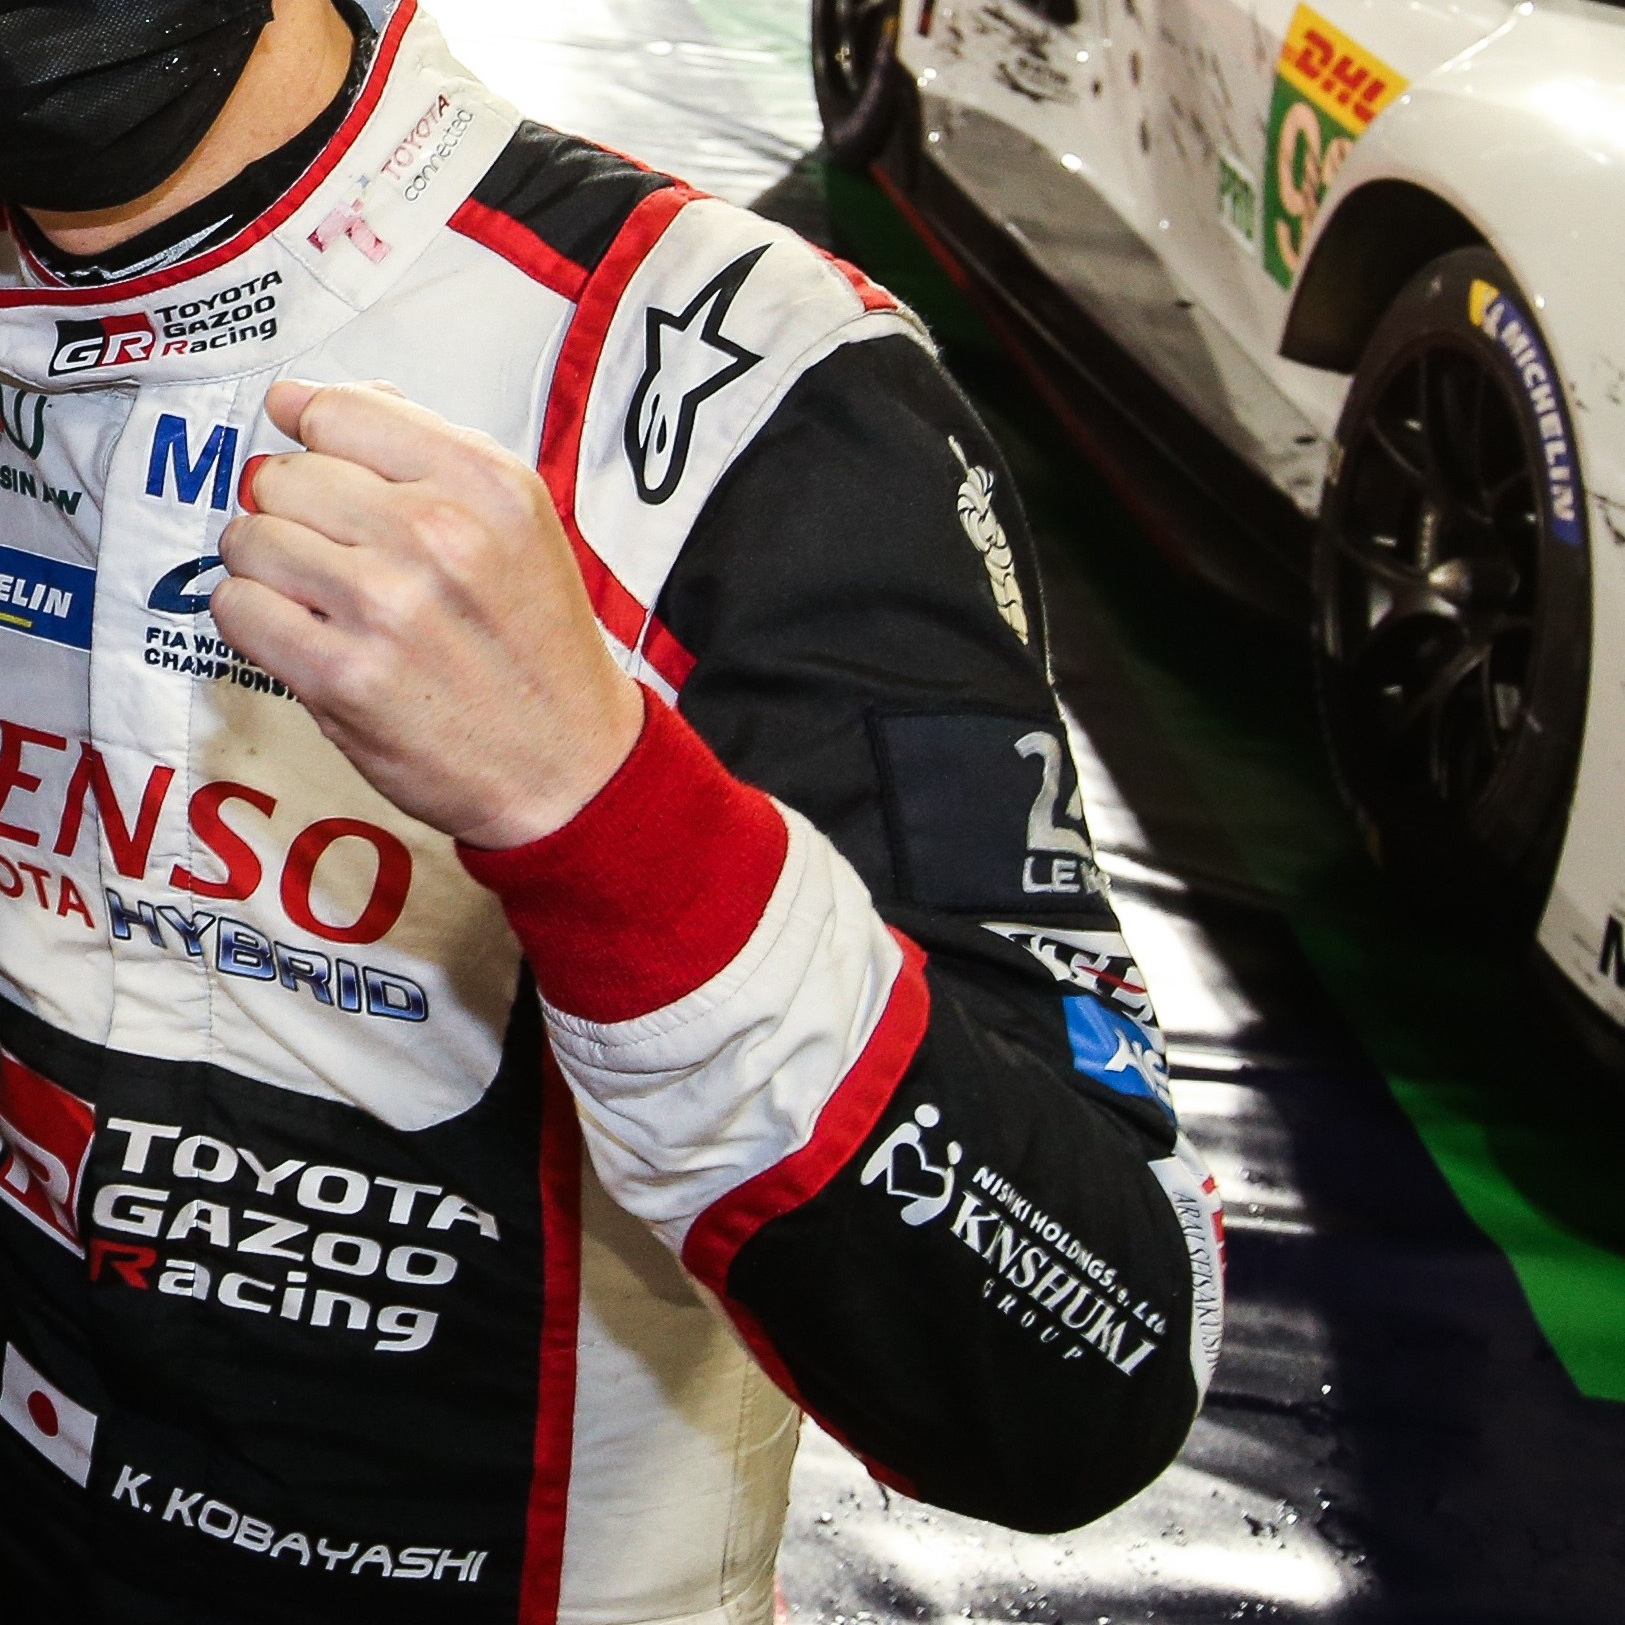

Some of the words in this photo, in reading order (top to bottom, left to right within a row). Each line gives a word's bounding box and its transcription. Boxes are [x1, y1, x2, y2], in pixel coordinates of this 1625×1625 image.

[1294, 29, 1386, 125] DHL
[381, 94, 449, 180] TOYOTA
[154, 271, 284, 323] TOYOTA
[163, 295, 277, 340] GAZOO
[56, 332, 153, 372] GR
[162, 317, 277, 357] Racing
[1501, 319, 1575, 523] MICHELIN
[145, 648, 304, 701] CHAMPIONS
[146, 627, 187, 650] FIA
[103, 890, 428, 1022] HYBRID
[107, 1118, 501, 1241] TOYOTA
[92, 1182, 458, 1284] GAZOO
[90, 1240, 440, 1352] Racing
[982, 1278, 1083, 1361] GROUP
[113, 1466, 152, 1512] K.
[164, 1488, 488, 1582] KOBAYASHI
